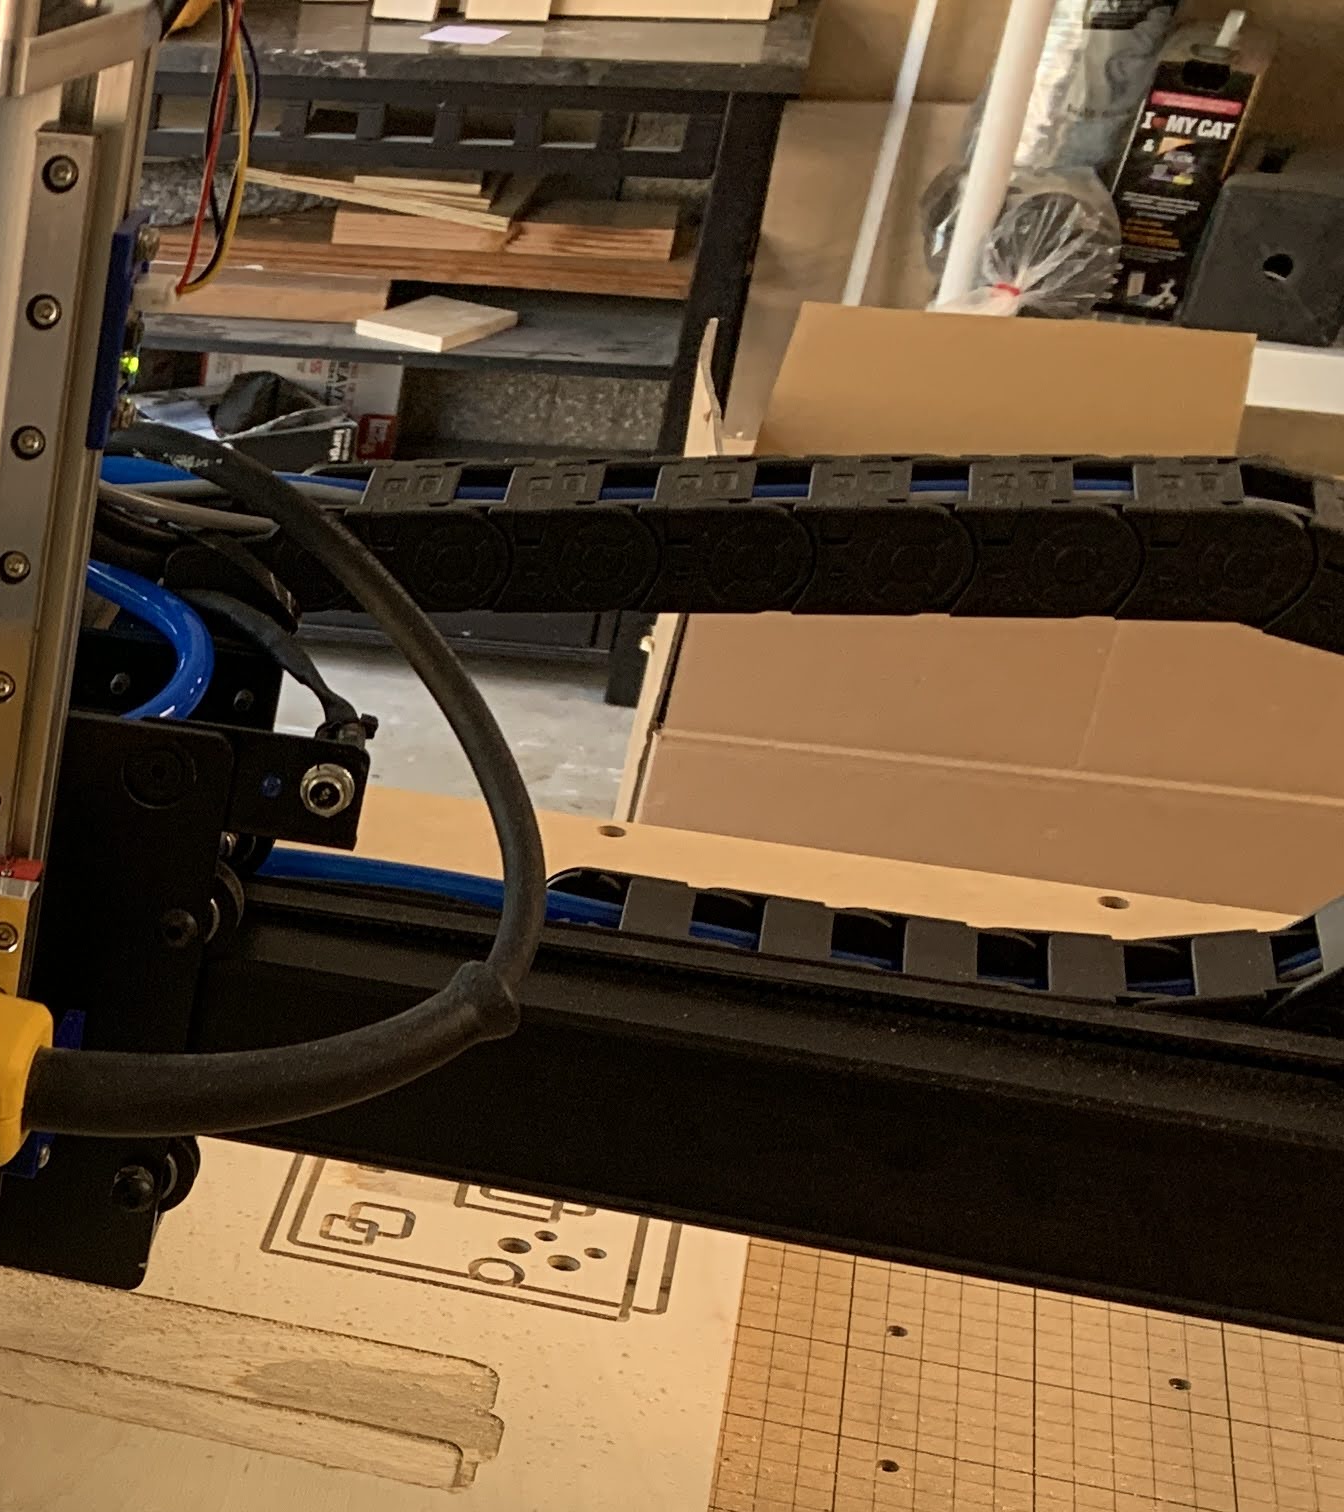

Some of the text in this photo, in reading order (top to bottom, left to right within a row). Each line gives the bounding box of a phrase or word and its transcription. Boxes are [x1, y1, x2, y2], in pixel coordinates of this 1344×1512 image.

[1141, 111, 1236, 141] I MY CAT
